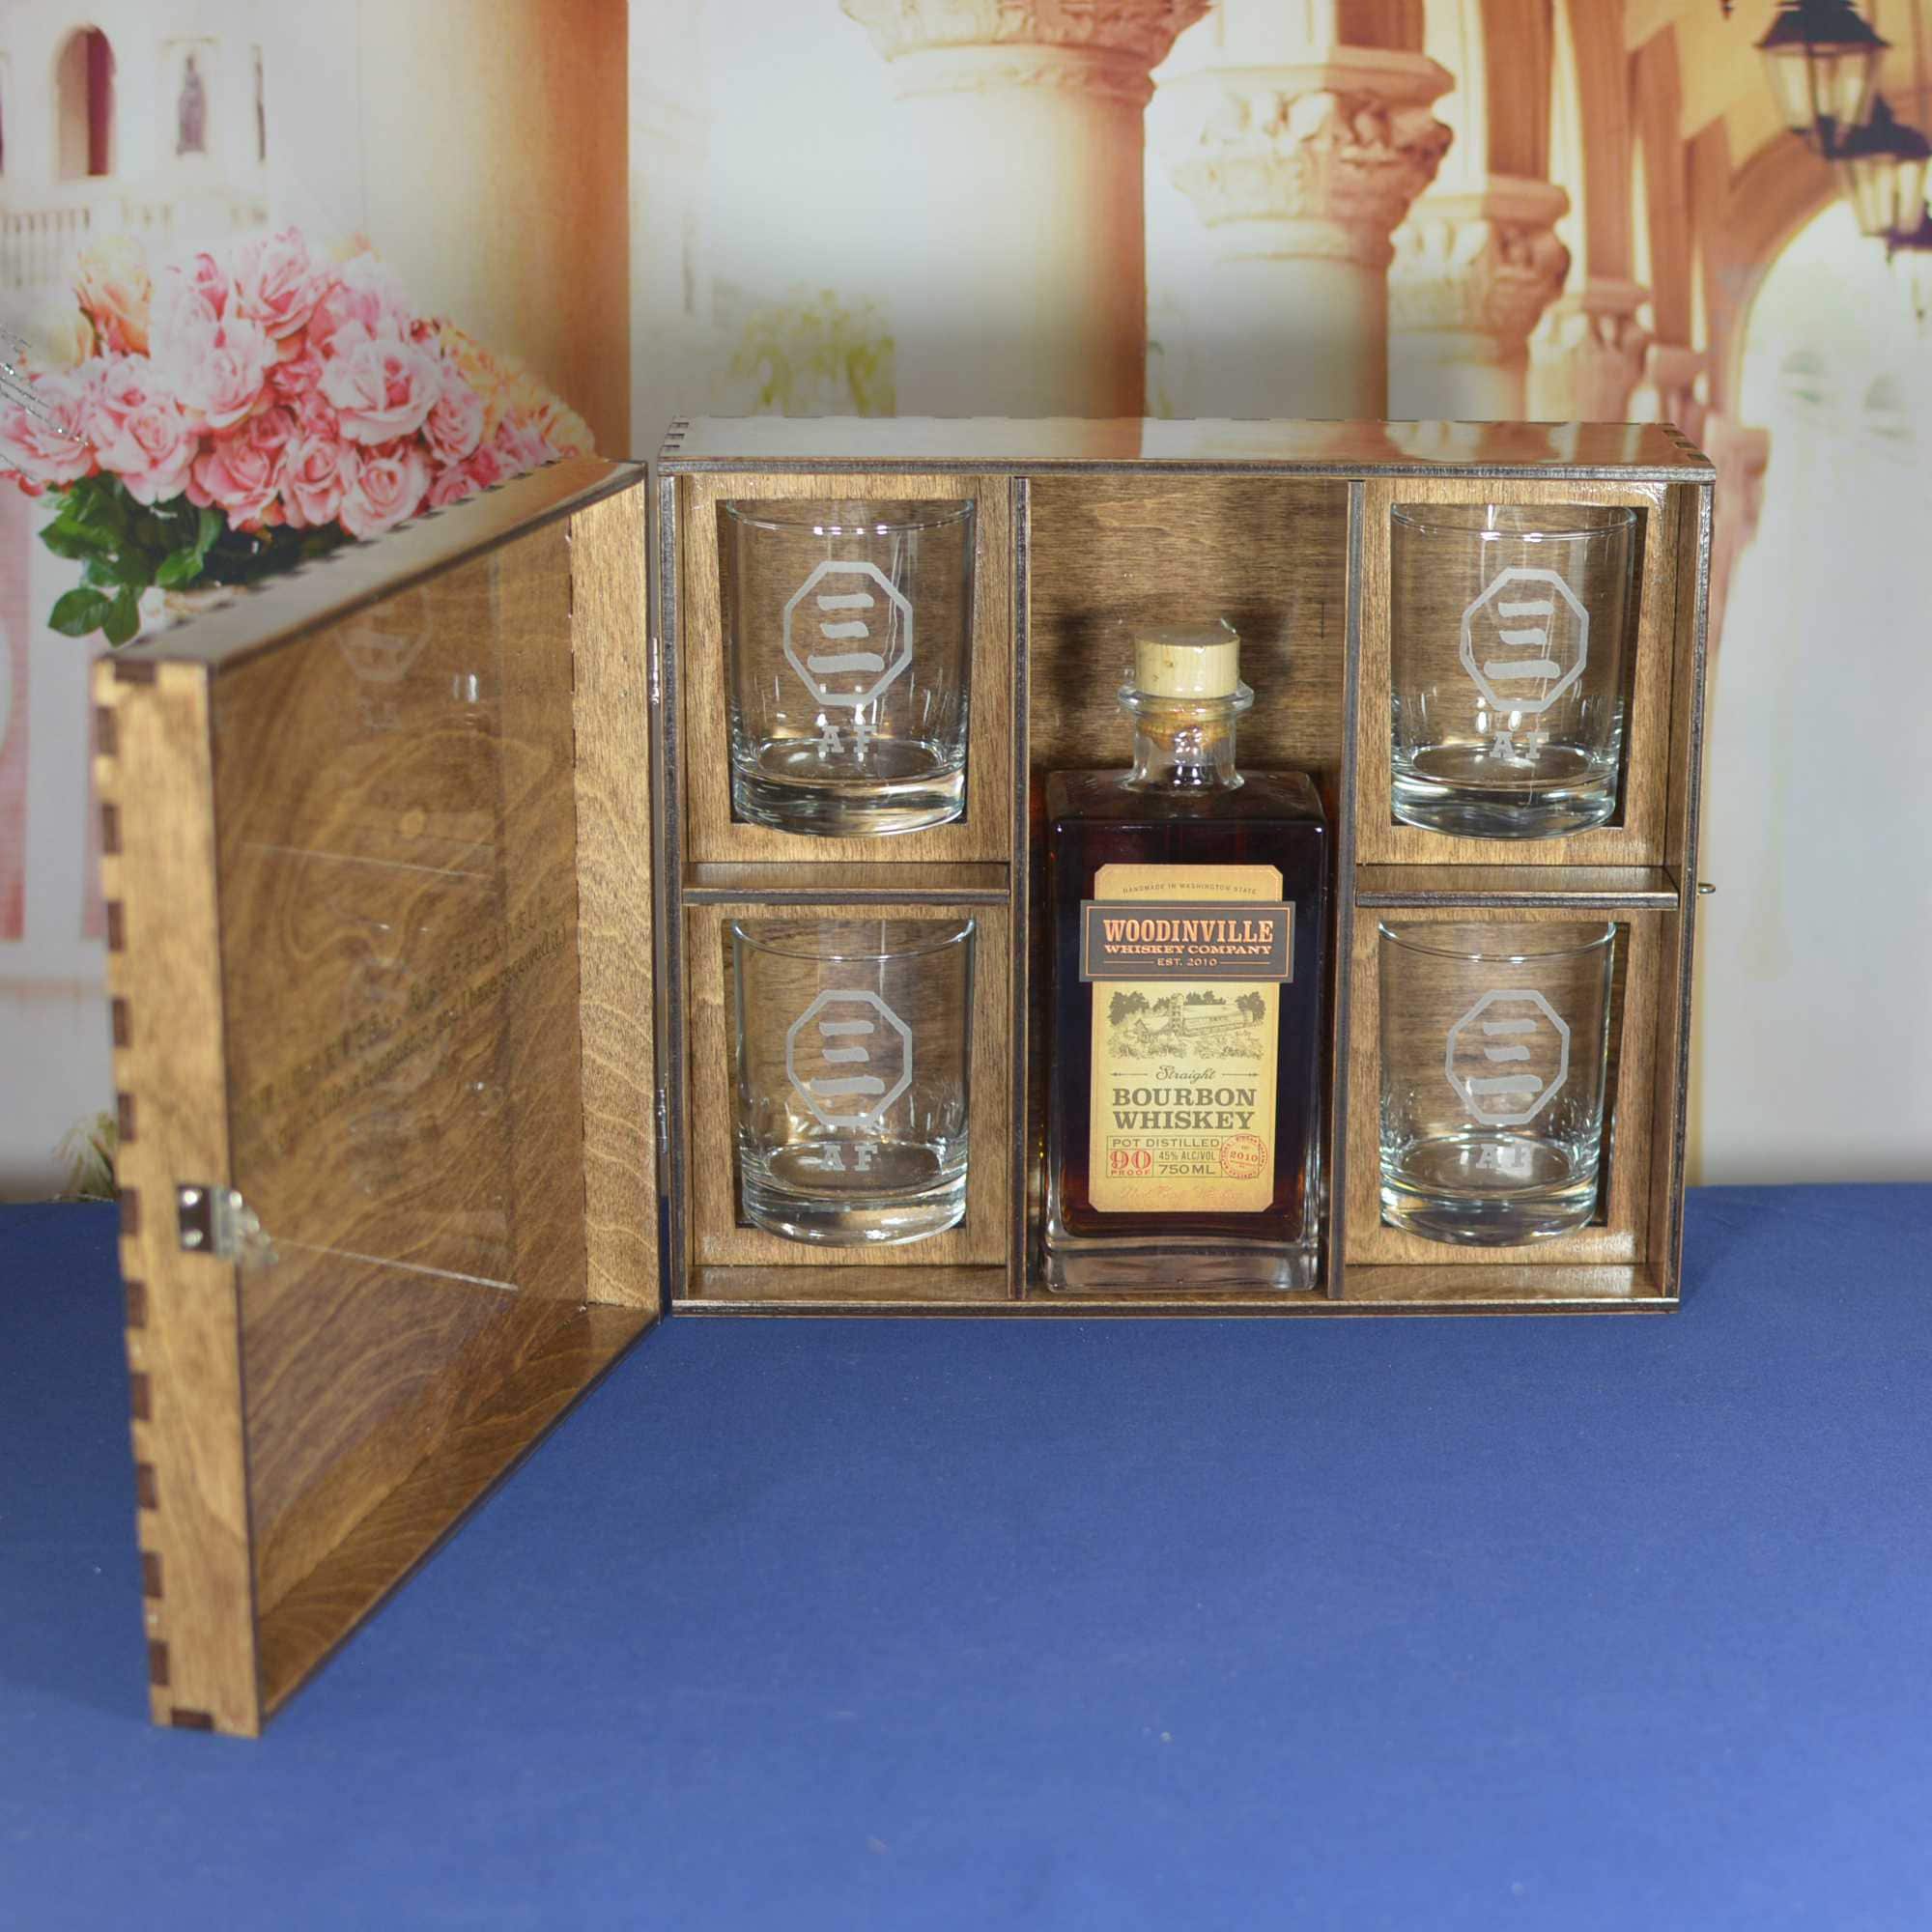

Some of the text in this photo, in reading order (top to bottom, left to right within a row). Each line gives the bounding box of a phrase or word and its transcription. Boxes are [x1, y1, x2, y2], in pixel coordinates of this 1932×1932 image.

[1122, 883, 1164, 894] HANDMADE
[1179, 883, 1230, 892] WASHINGTON
[1103, 919, 1274, 943] WOODINVILLE
[1104, 945, 1272, 955] WHISKEY COMPANY
[1157, 957, 1218, 967] EST. 2010
[1155, 1065, 1215, 1084] Straight
[1112, 1088, 1257, 1107] BOURBON
[1112, 1110, 1255, 1130] WHISKEY
[1112, 1138, 1220, 1148] POT DISTILLED
[1110, 1150, 1151, 1170] 90
[1159, 1151, 1179, 1161] 45%
